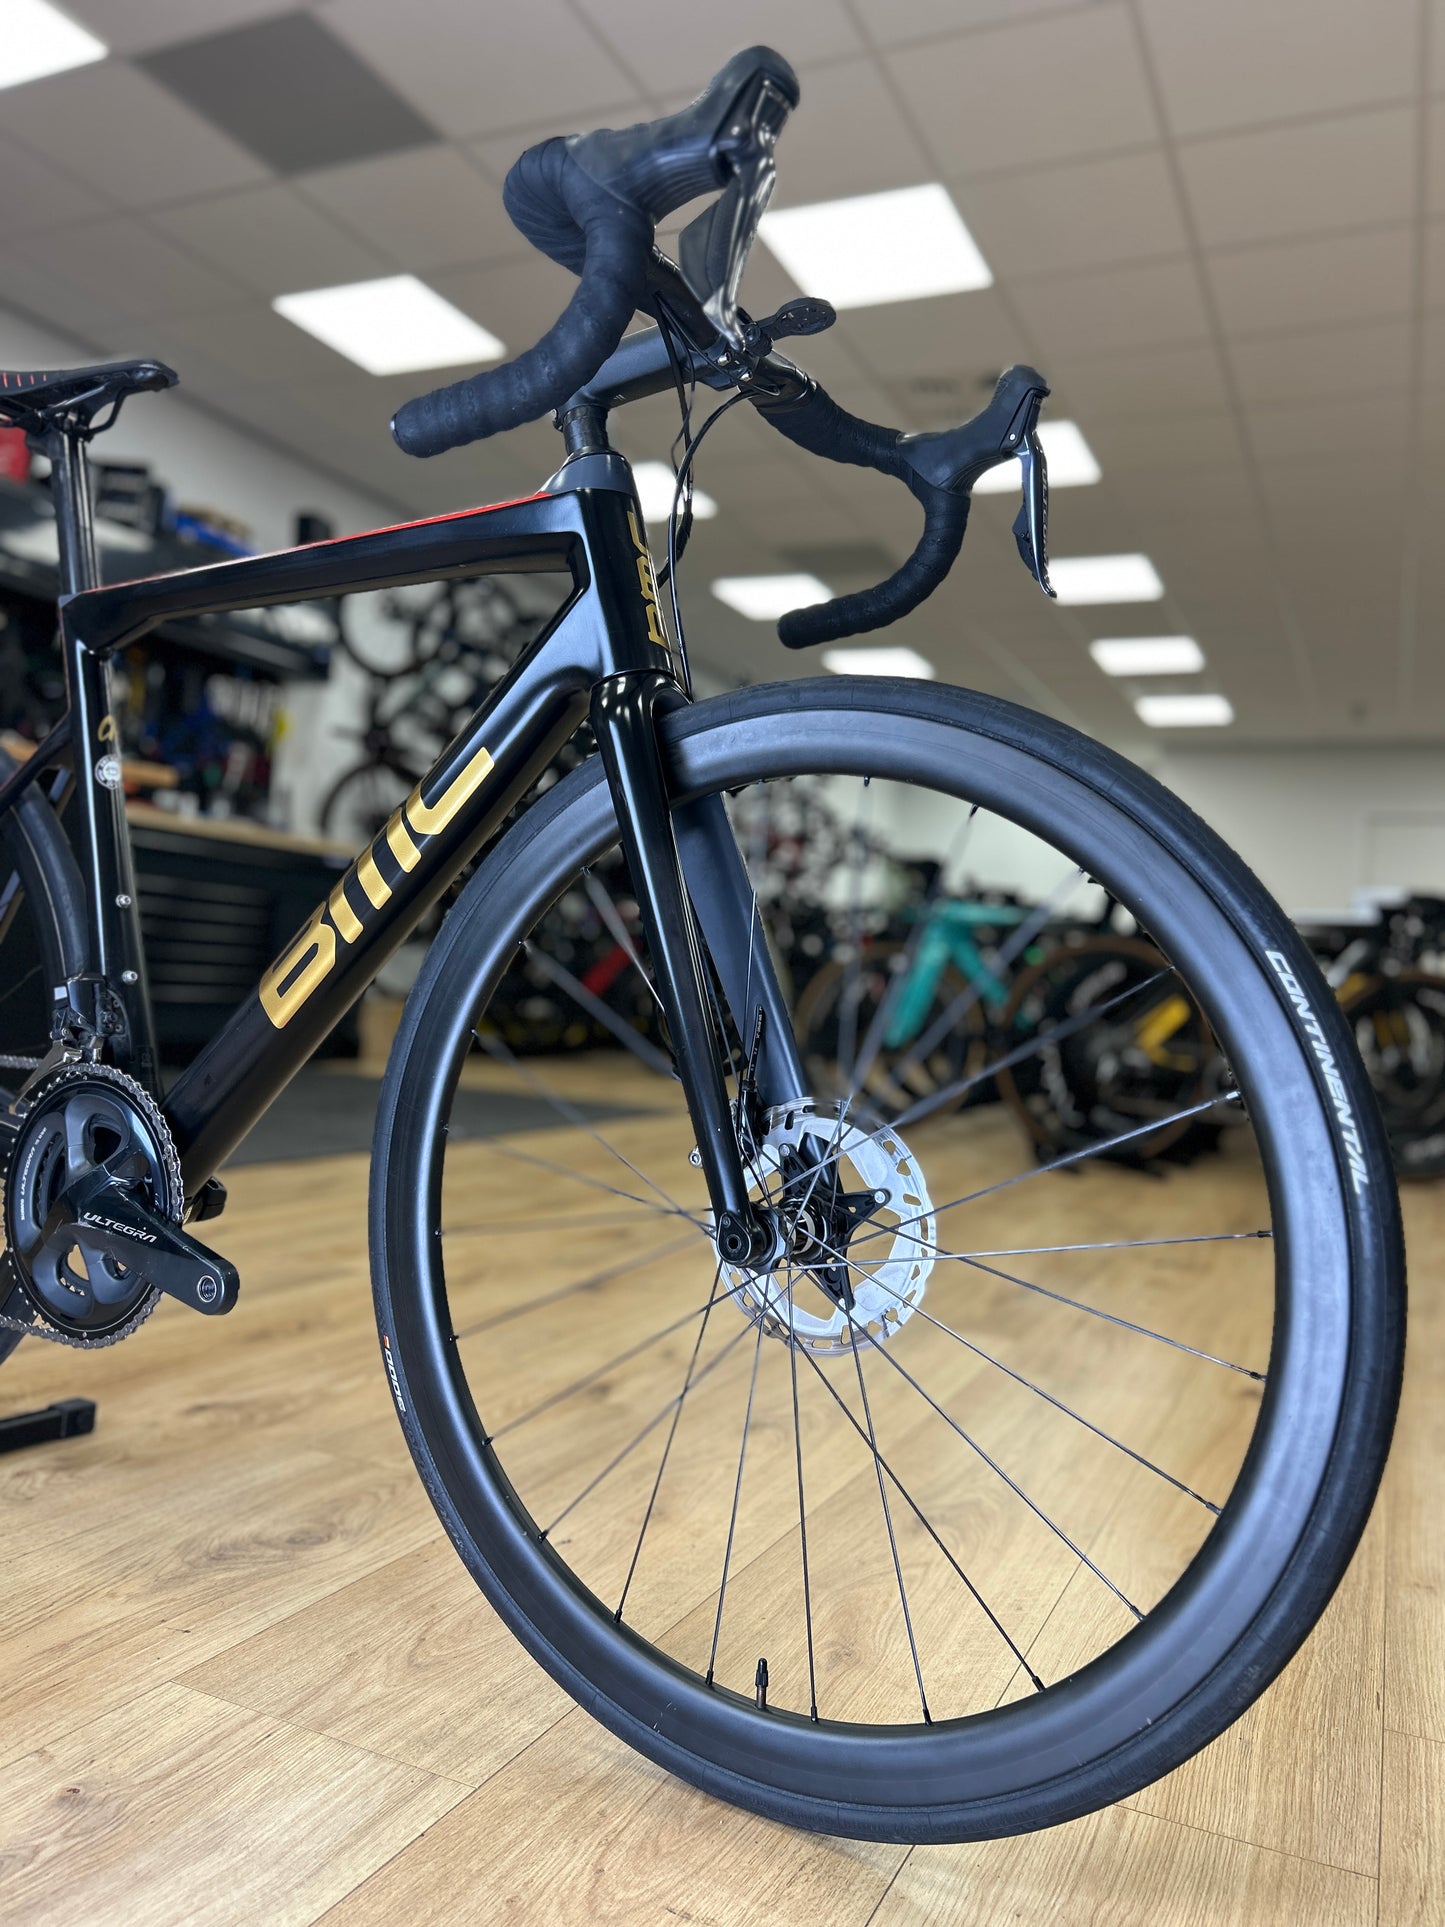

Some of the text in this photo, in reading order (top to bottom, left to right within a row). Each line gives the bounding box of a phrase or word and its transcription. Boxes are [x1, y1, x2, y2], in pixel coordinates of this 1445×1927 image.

[259, 747, 494, 1029] BMC
[1265, 950, 1369, 1195] CONTINENTAL
[84, 1212, 157, 1243] ULTEGRA
